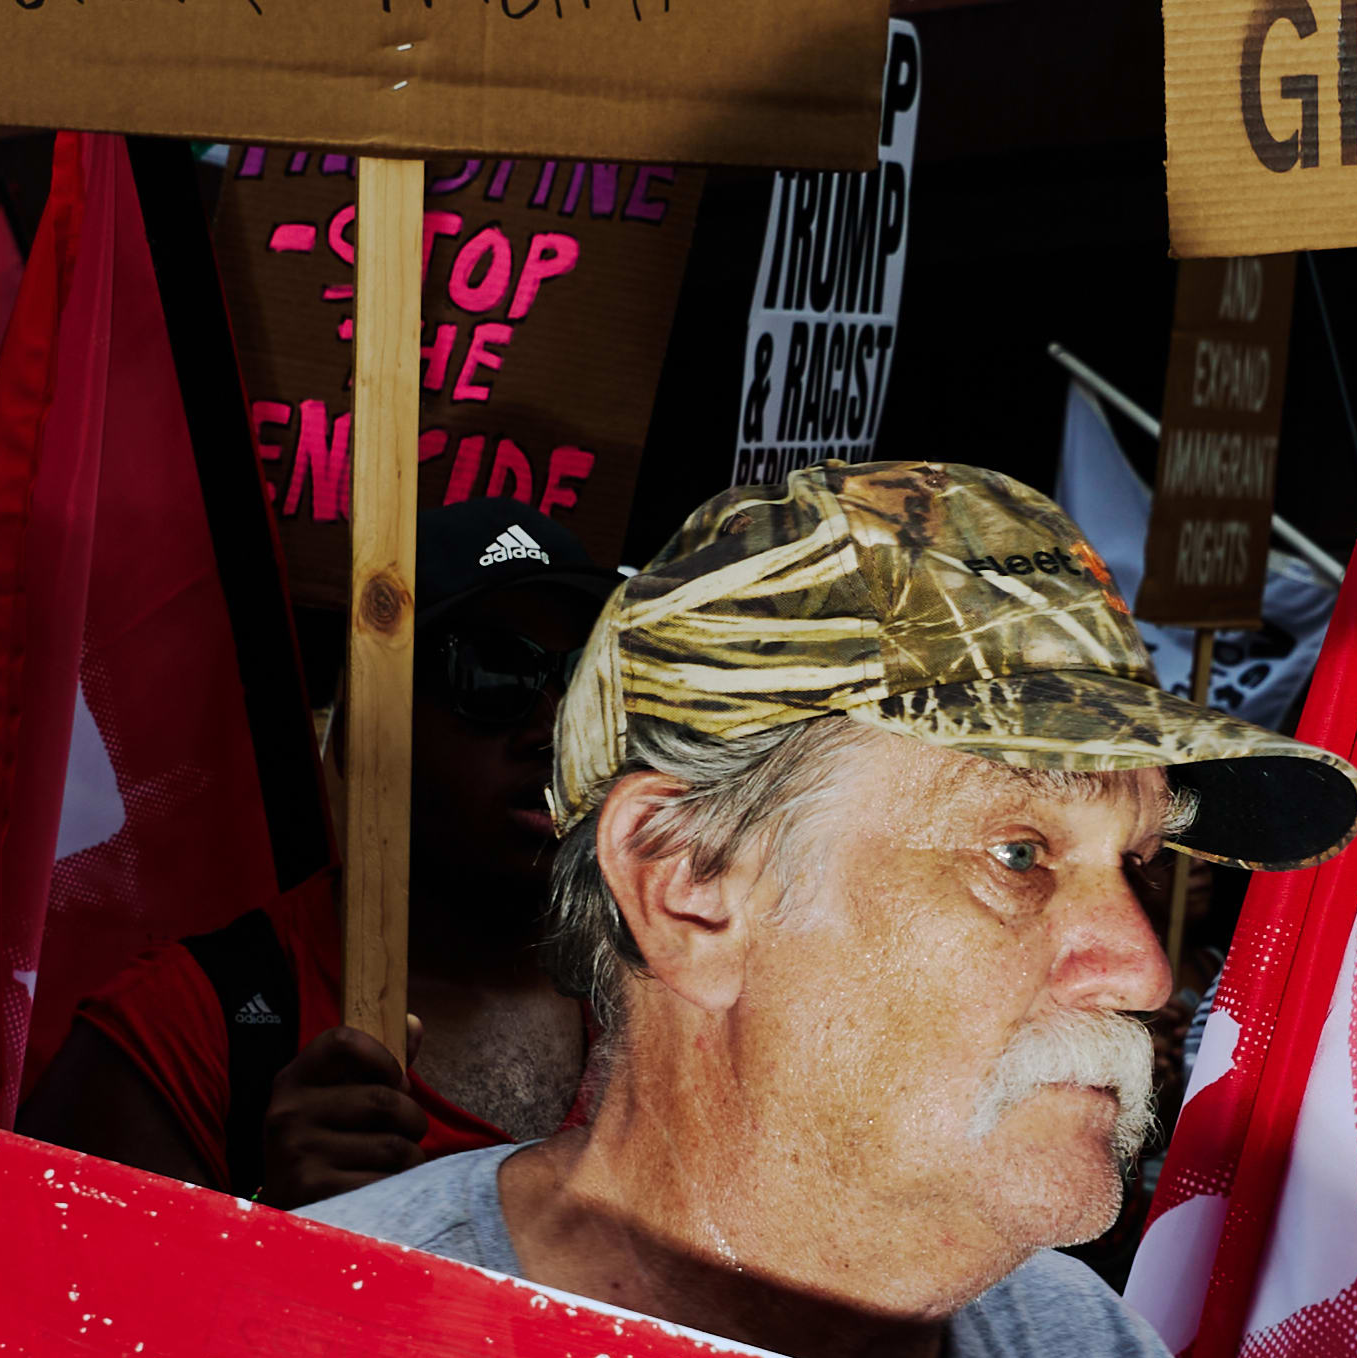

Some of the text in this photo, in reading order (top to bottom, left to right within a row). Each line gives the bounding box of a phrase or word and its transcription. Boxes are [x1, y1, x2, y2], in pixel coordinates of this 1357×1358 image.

[763, 161, 907, 314] TRUMP
[742, 321, 895, 443] & RACIST
[1191, 338, 1272, 413] EXPAND
[1162, 428, 1280, 498] IMMIGRANT
[479, 546, 550, 567] adidas
[963, 546, 1082, 577] Fleet
[1175, 519, 1251, 586] RIGHTS
[234, 1010, 282, 1024] adidas
